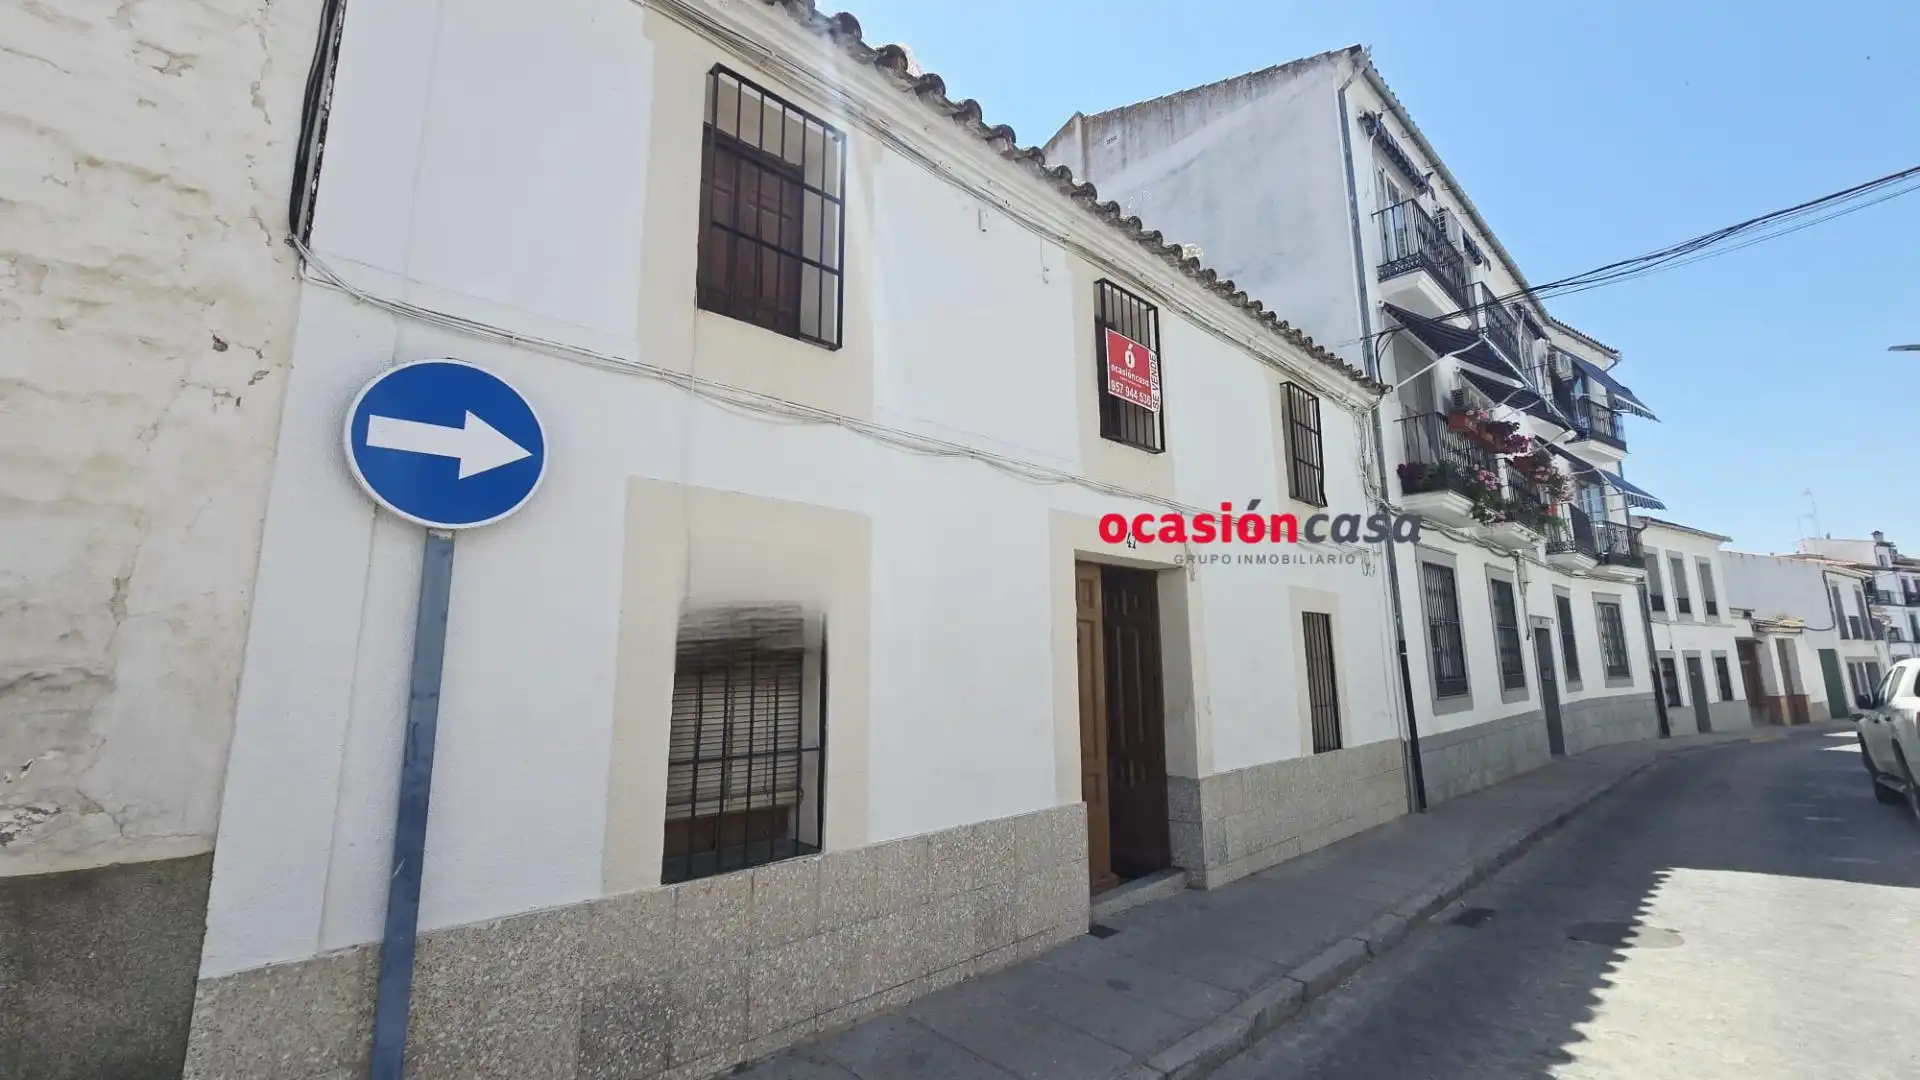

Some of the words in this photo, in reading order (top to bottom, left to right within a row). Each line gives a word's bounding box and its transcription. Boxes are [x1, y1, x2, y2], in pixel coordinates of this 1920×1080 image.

[1150, 354, 1158, 390] VENDE
[1111, 380, 1123, 394] 957
[1125, 385, 1138, 400] 944
[1152, 393, 1159, 410] SE
